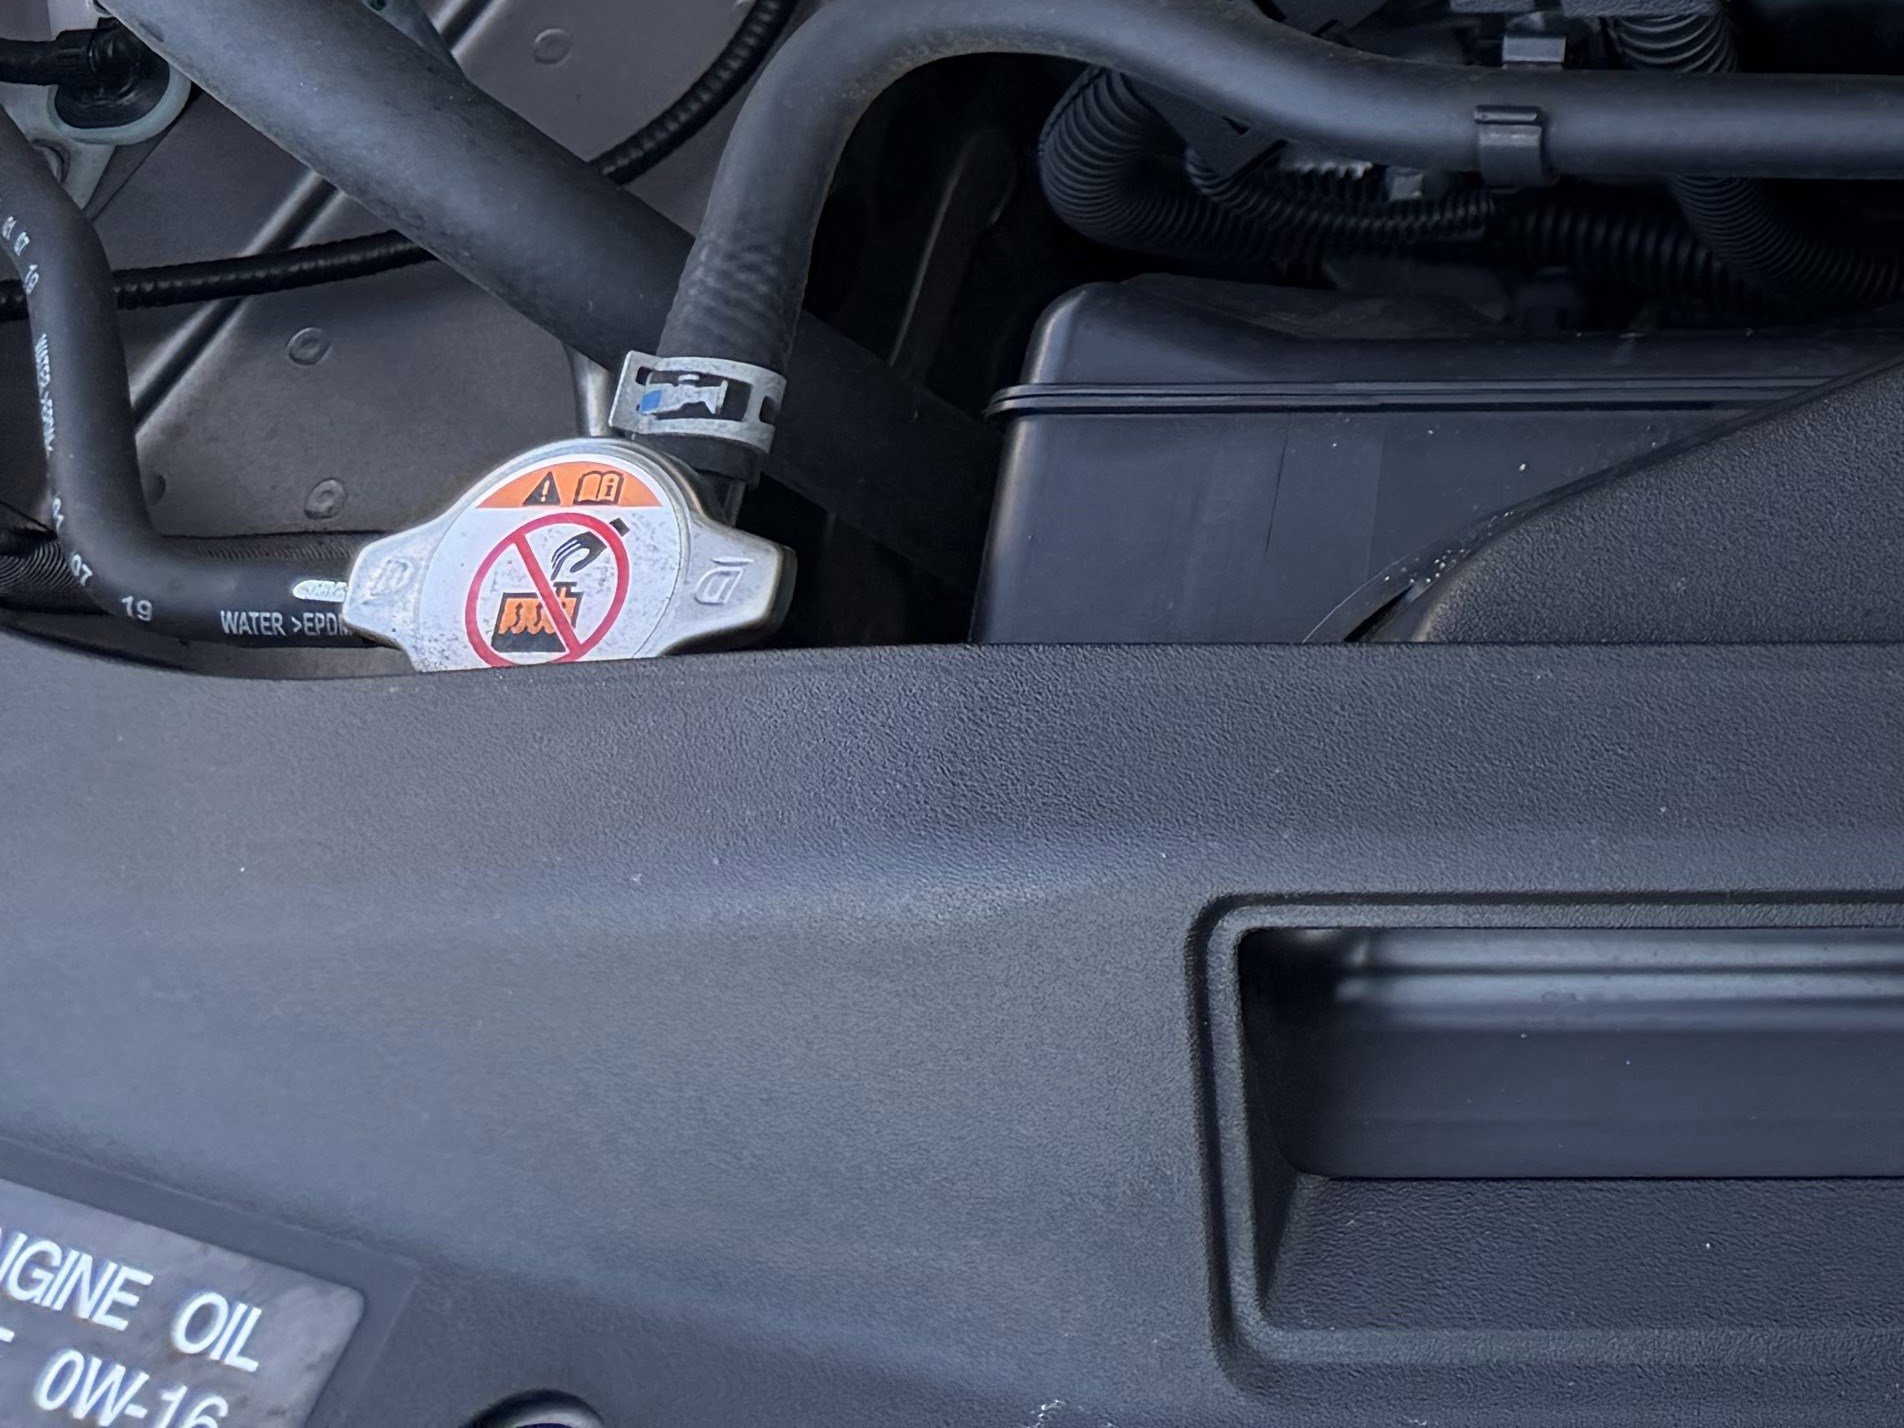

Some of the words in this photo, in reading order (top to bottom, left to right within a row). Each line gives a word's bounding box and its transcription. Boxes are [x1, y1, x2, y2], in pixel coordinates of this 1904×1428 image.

[70, 554, 92, 587] 07
[121, 595, 152, 622] 19
[220, 610, 286, 637] WATER
[171, 1292, 262, 1373] OIL
[34, 1348, 229, 1428] 0W-16
